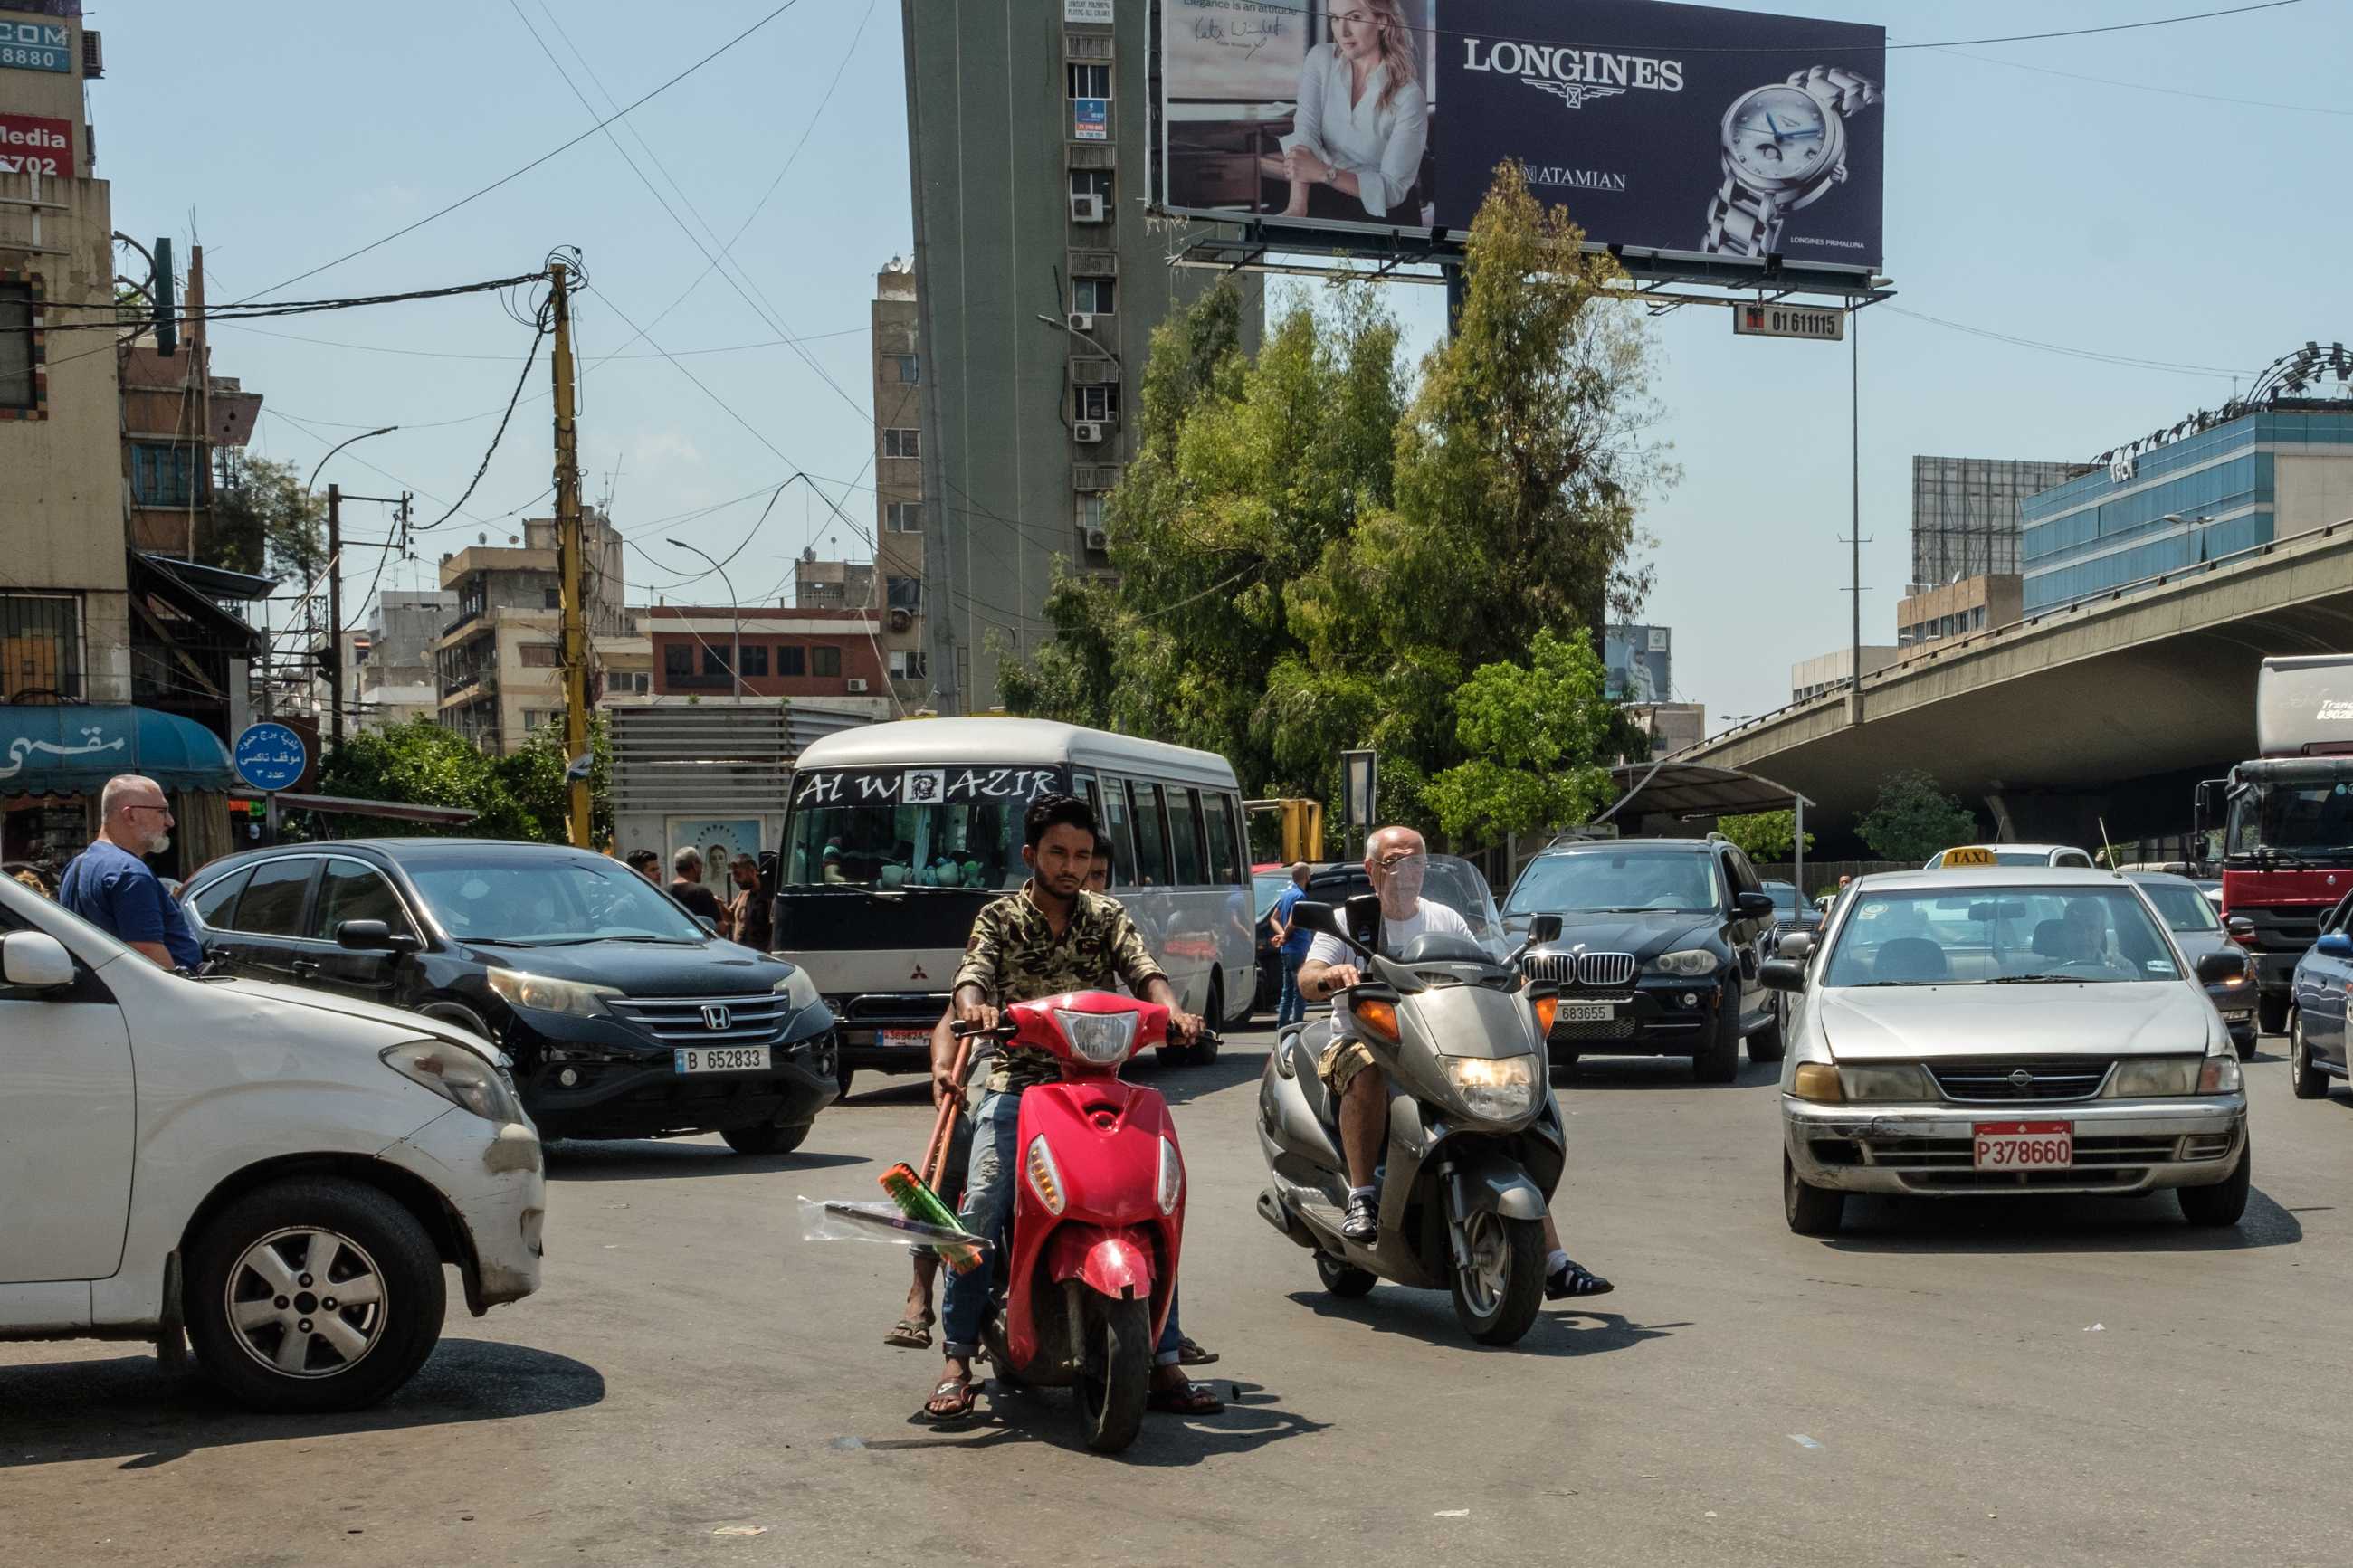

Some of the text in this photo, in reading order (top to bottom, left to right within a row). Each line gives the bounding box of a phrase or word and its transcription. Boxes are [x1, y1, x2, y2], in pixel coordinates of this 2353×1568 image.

[1463, 38, 1684, 92] LONGINES
[1538, 166, 1626, 189] ATAMIAN
[1773, 311, 1835, 335] 01 611115
[272, 751, 300, 765] موقف
[855, 775, 901, 798] W
[1950, 851, 1989, 863] TAXI
[688, 1050, 760, 1069] B 652833
[1977, 1140, 2070, 1164] P378660
